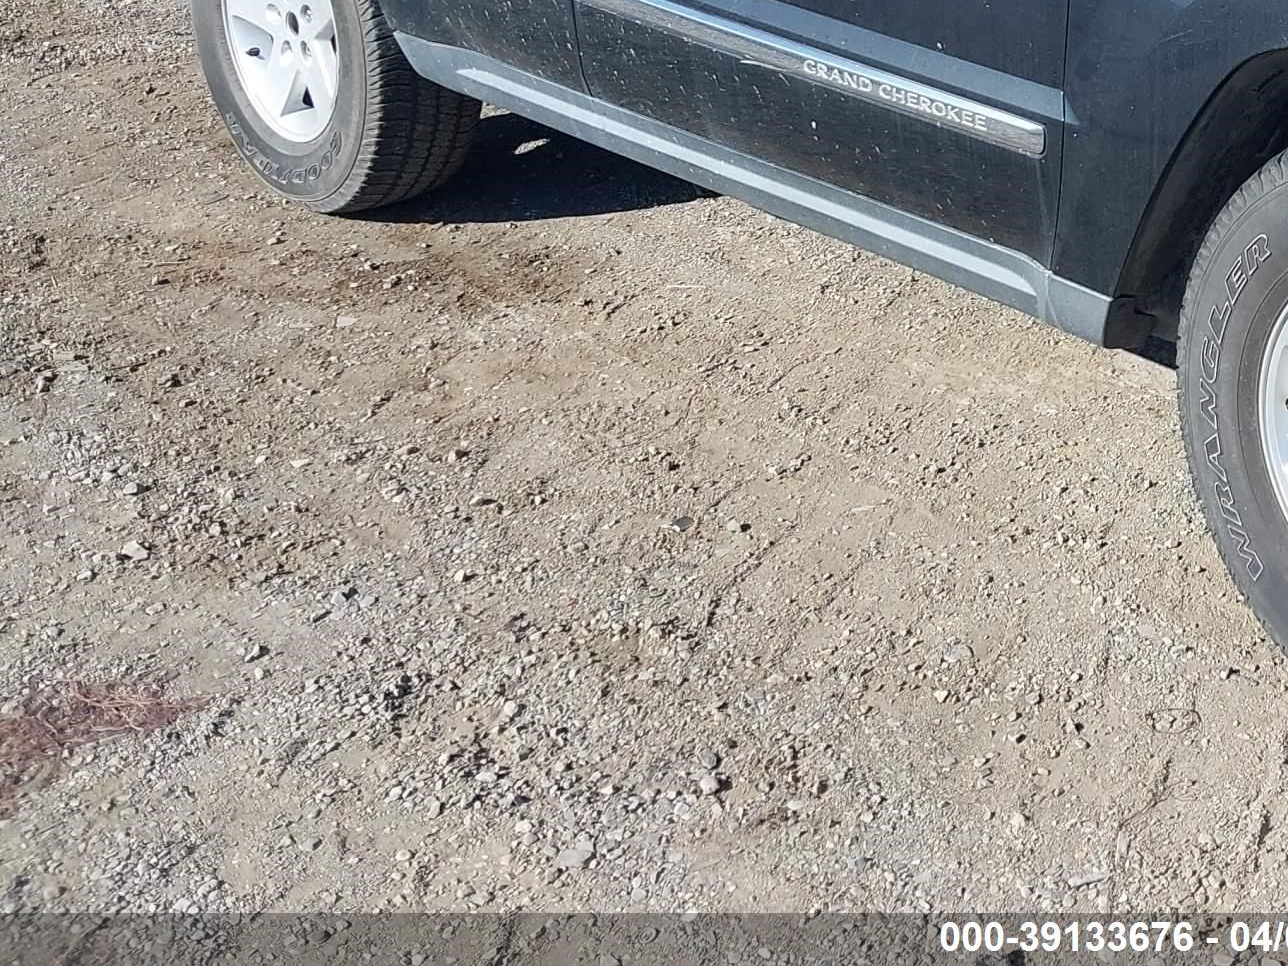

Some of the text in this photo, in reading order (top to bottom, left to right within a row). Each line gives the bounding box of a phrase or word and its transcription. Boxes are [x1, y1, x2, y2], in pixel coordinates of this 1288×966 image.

[803, 59, 987, 131] GRAND CHEROKEE
[1200, 233, 1272, 582] WRANGLER
